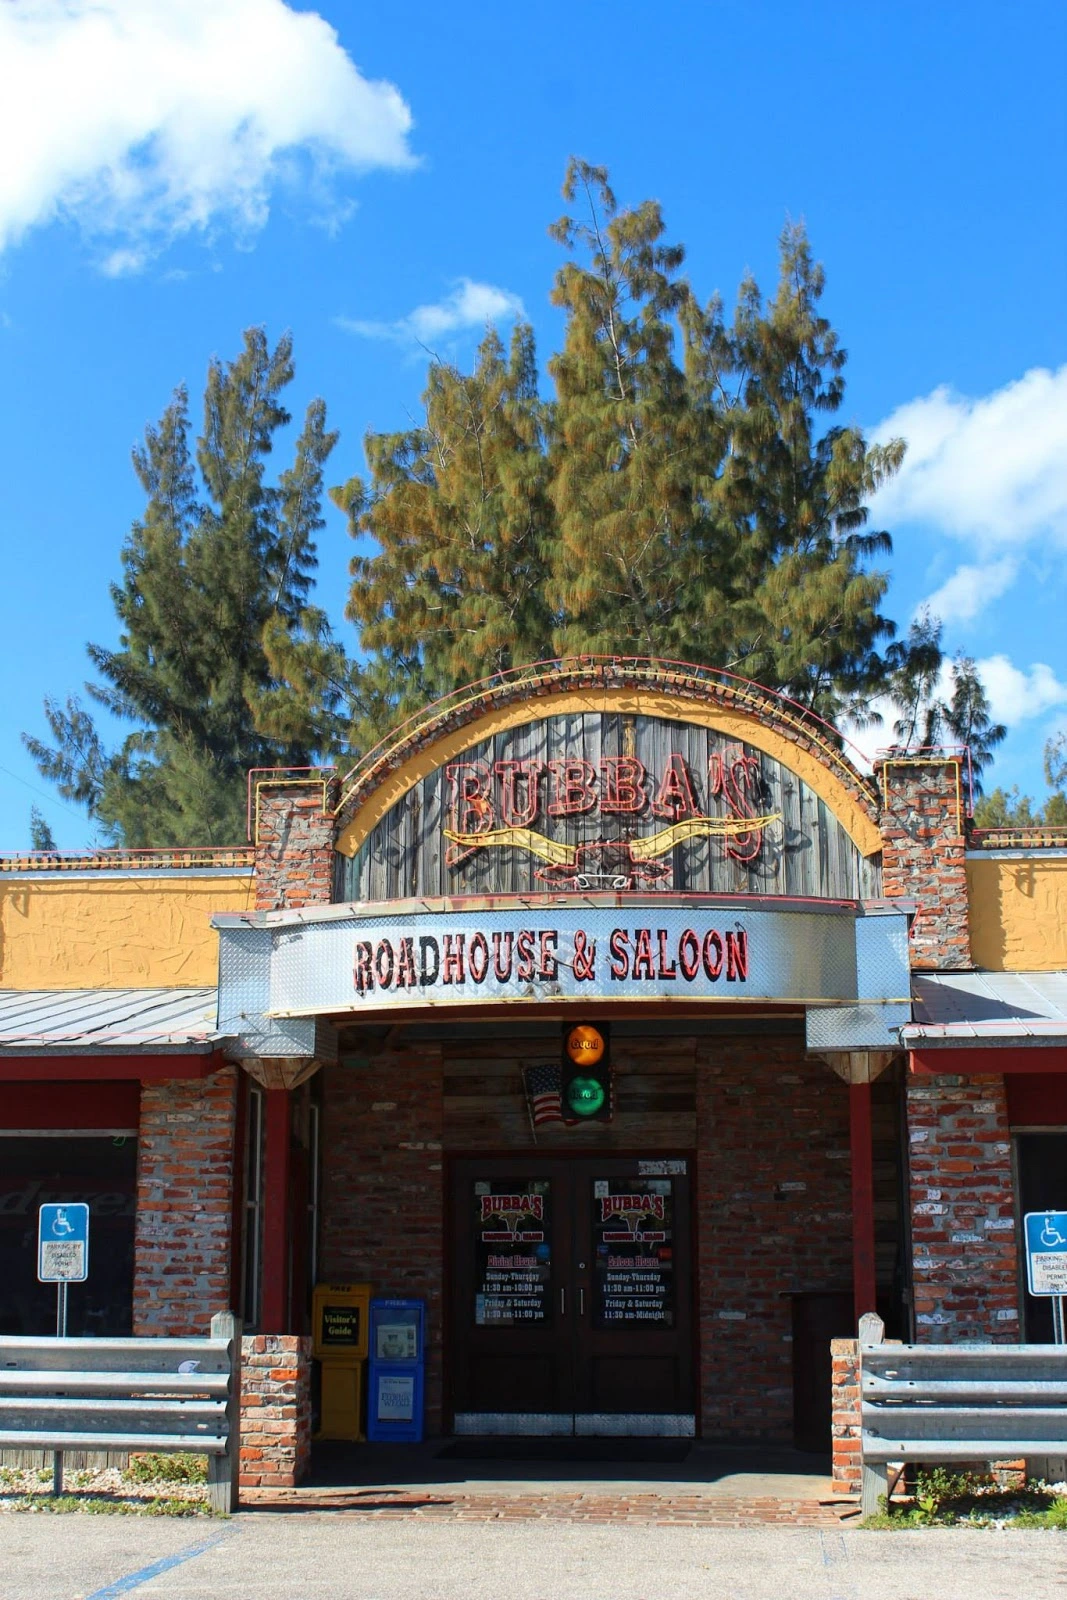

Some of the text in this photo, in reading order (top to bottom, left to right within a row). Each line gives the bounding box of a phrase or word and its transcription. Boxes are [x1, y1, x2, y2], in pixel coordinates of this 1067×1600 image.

[445, 746, 761, 865] BUBBA'S
[353, 929, 749, 991] ROADHOUSE & SALOON
[481, 1194, 543, 1221] BUBBA'S
[601, 1194, 664, 1222] BUBBA'S
[608, 1256, 659, 1267] Saloon Hours
[482, 1283, 501, 1292] 11:30
[534, 1285, 544, 1293] pm
[603, 1284, 622, 1292] 11:30
[655, 1285, 666, 1294] pm
[485, 1299, 542, 1308] Friday & Saturday
[605, 1300, 664, 1309] Friday & Saturday
[324, 1314, 357, 1324] Visitor's
[534, 1311, 545, 1320] pm
[604, 1310, 665, 1320] 11:30 am-Midnight
[327, 1326, 353, 1336] Guide
